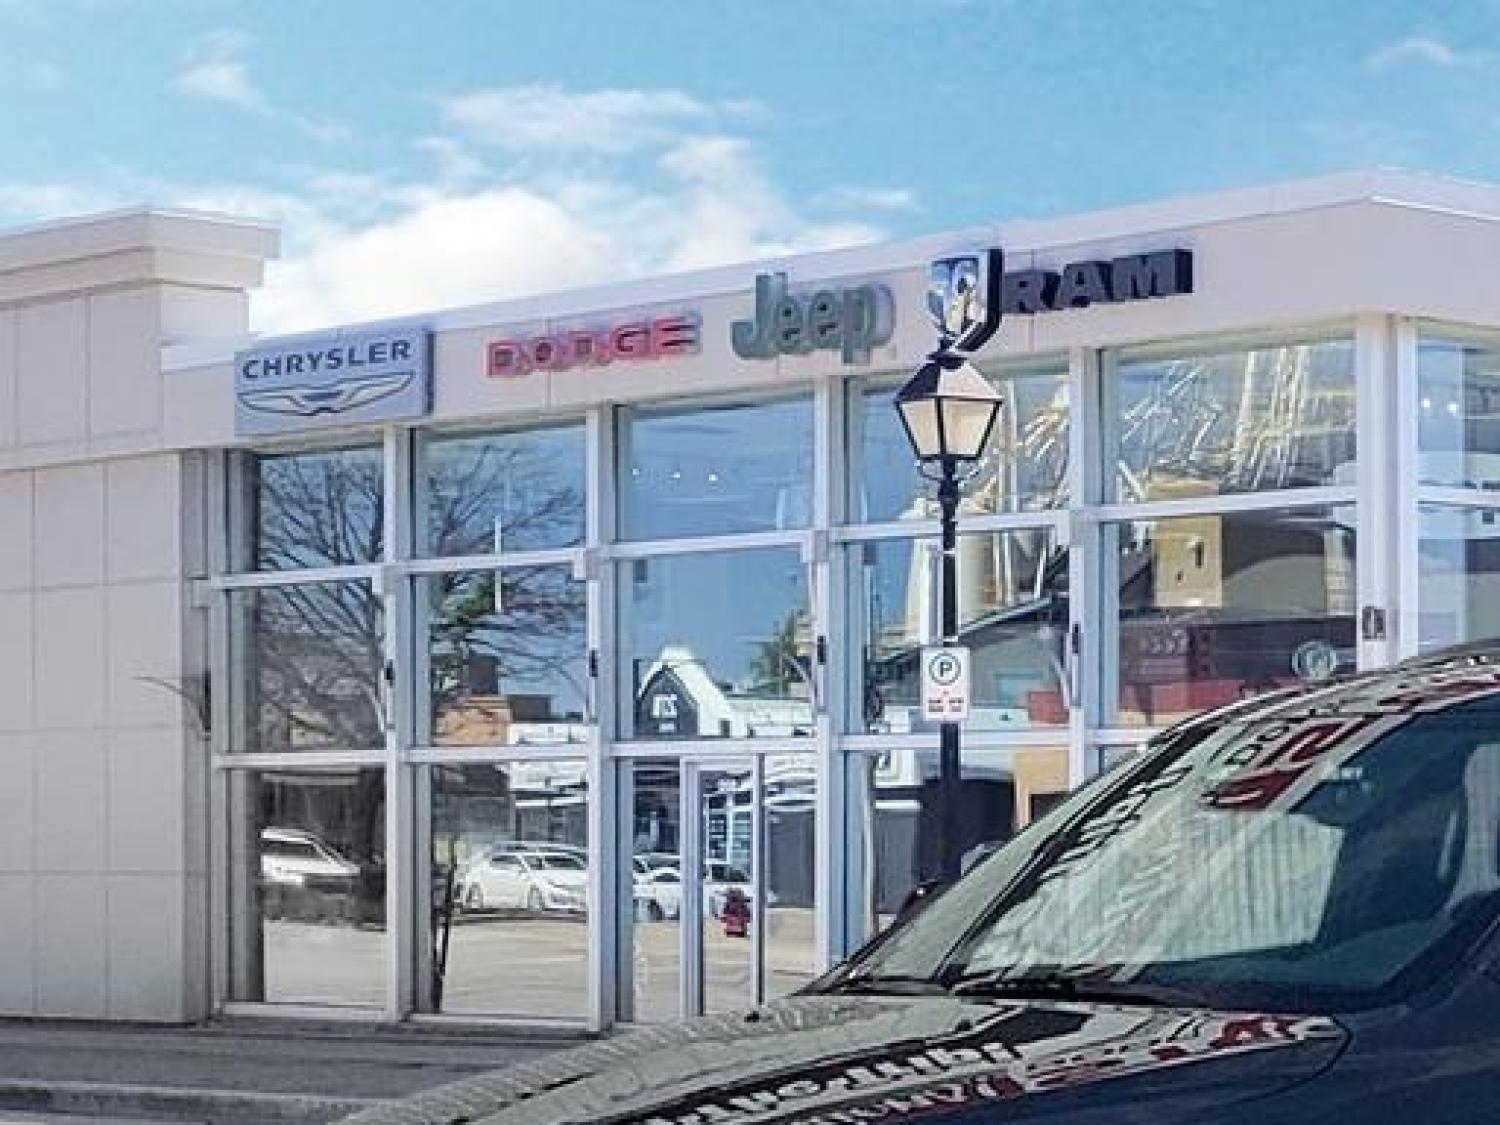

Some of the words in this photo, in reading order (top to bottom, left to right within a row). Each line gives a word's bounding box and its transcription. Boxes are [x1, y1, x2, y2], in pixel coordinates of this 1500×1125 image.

[1000, 248, 1193, 315] RAM
[486, 315, 698, 378] DODGE
[731, 272, 895, 364] Jeep
[241, 339, 412, 380] CHRYSLER
